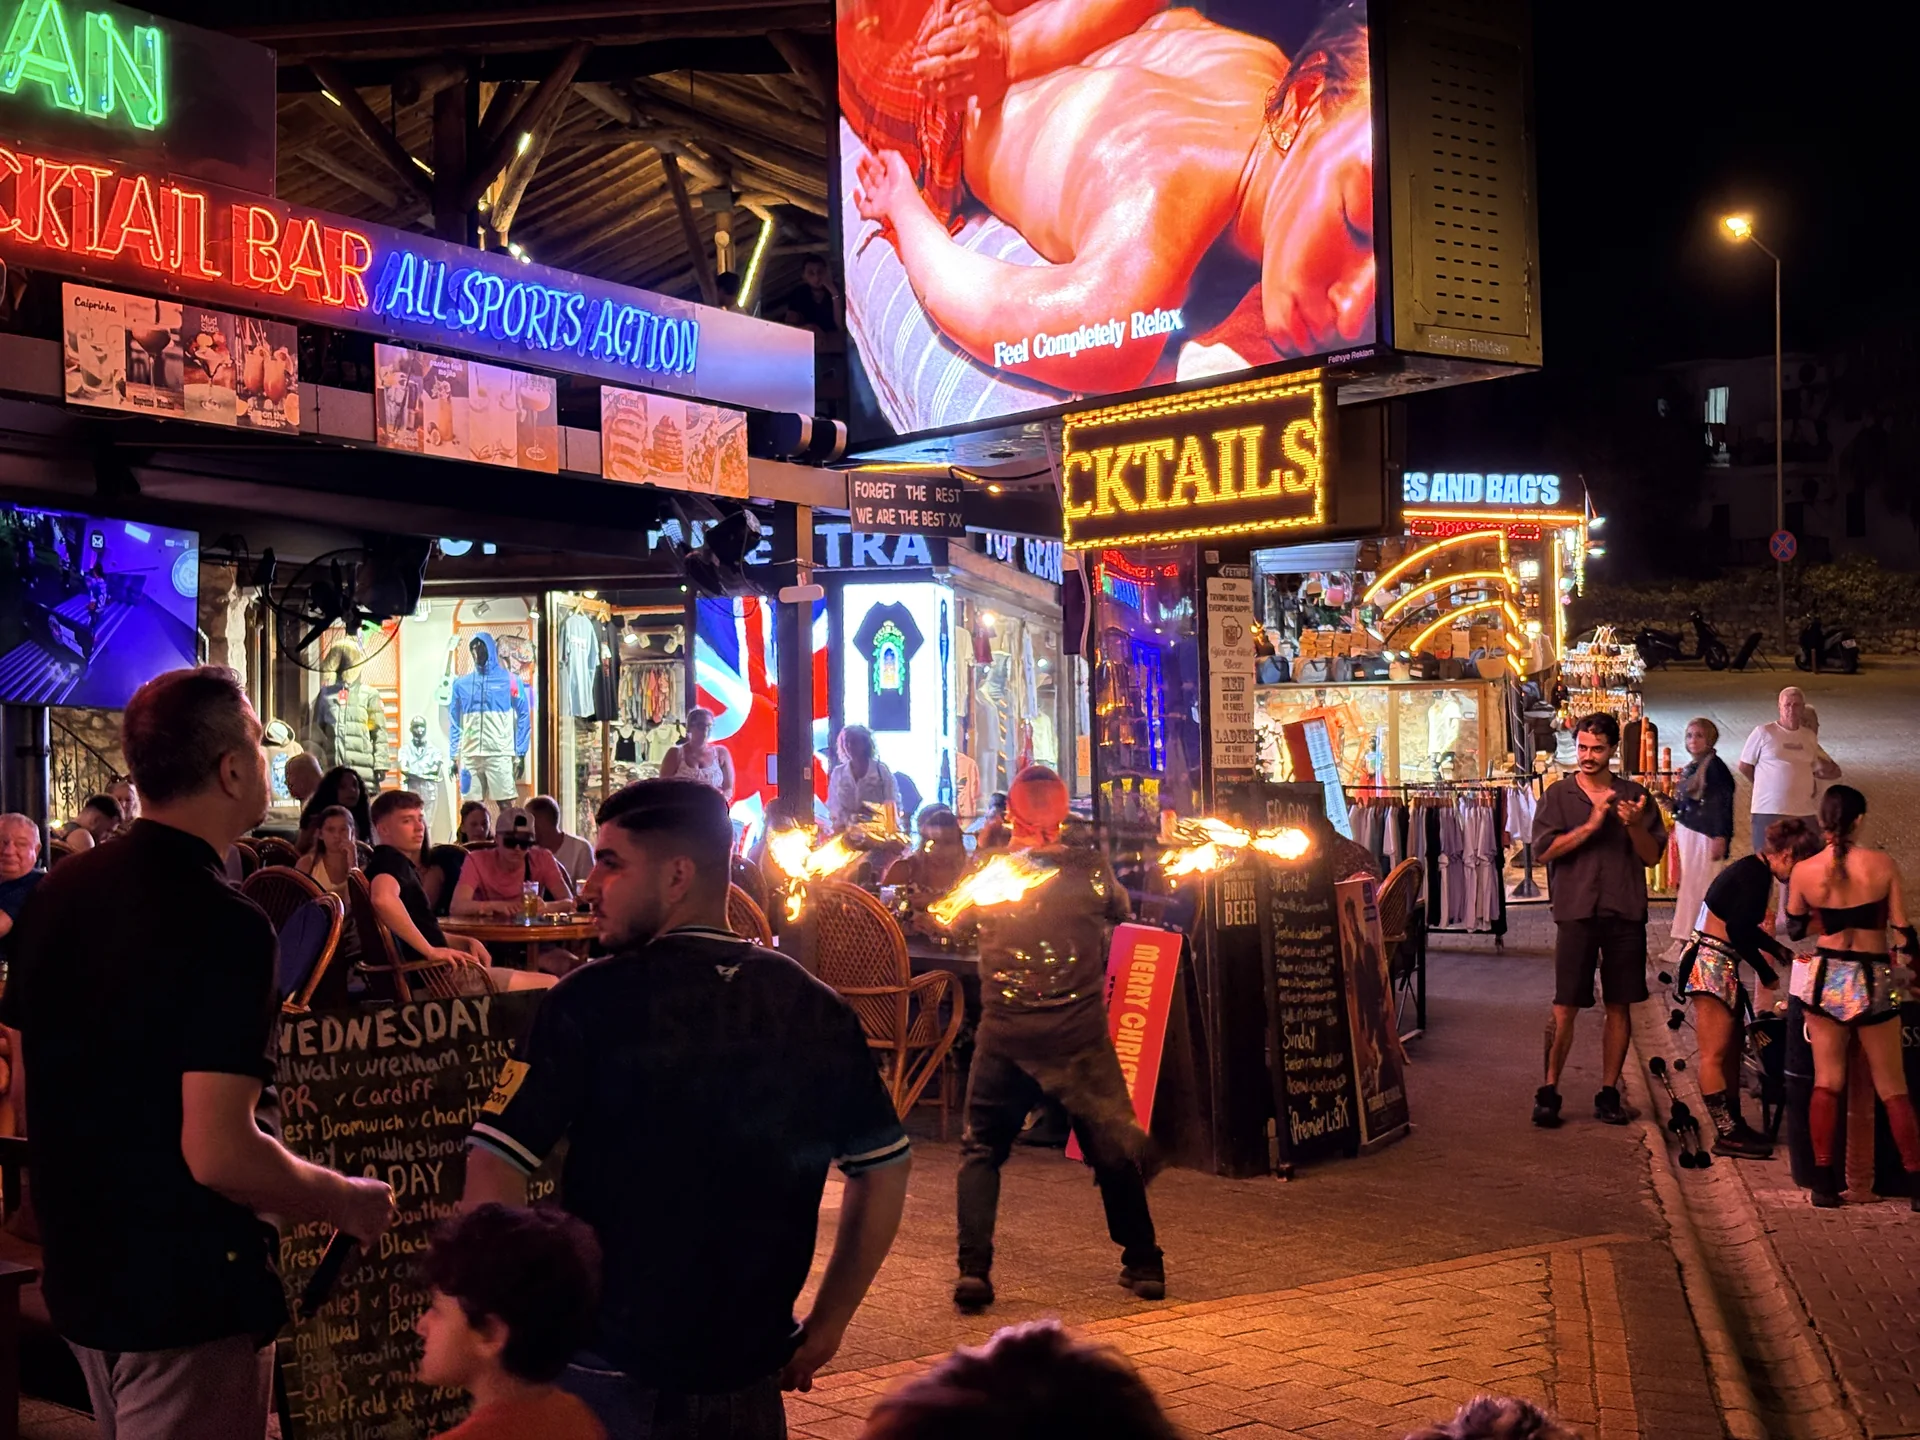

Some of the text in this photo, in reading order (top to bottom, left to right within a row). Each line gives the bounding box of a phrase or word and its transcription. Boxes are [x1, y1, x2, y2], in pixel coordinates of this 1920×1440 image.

[232, 205, 373, 311] BAR
[200, 314, 218, 326] Mud
[373, 252, 698, 377] ALL SPORTS ACTION
[994, 308, 1184, 368] Feel Completely Relax
[854, 481, 960, 503] FORGET THE REST
[1430, 473, 1482, 502] AND
[1485, 473, 1560, 505] BAG'S
[856, 507, 963, 528] WE ARE THE BEST XX
[1222, 583, 1236, 591] STOP
[1208, 604, 1234, 613] EVERYONE
[1214, 729, 1254, 743] LADIES
[1223, 881, 1256, 900] DRINK
[1225, 900, 1257, 925] BEER
[1124, 944, 1161, 1011] MERRY
